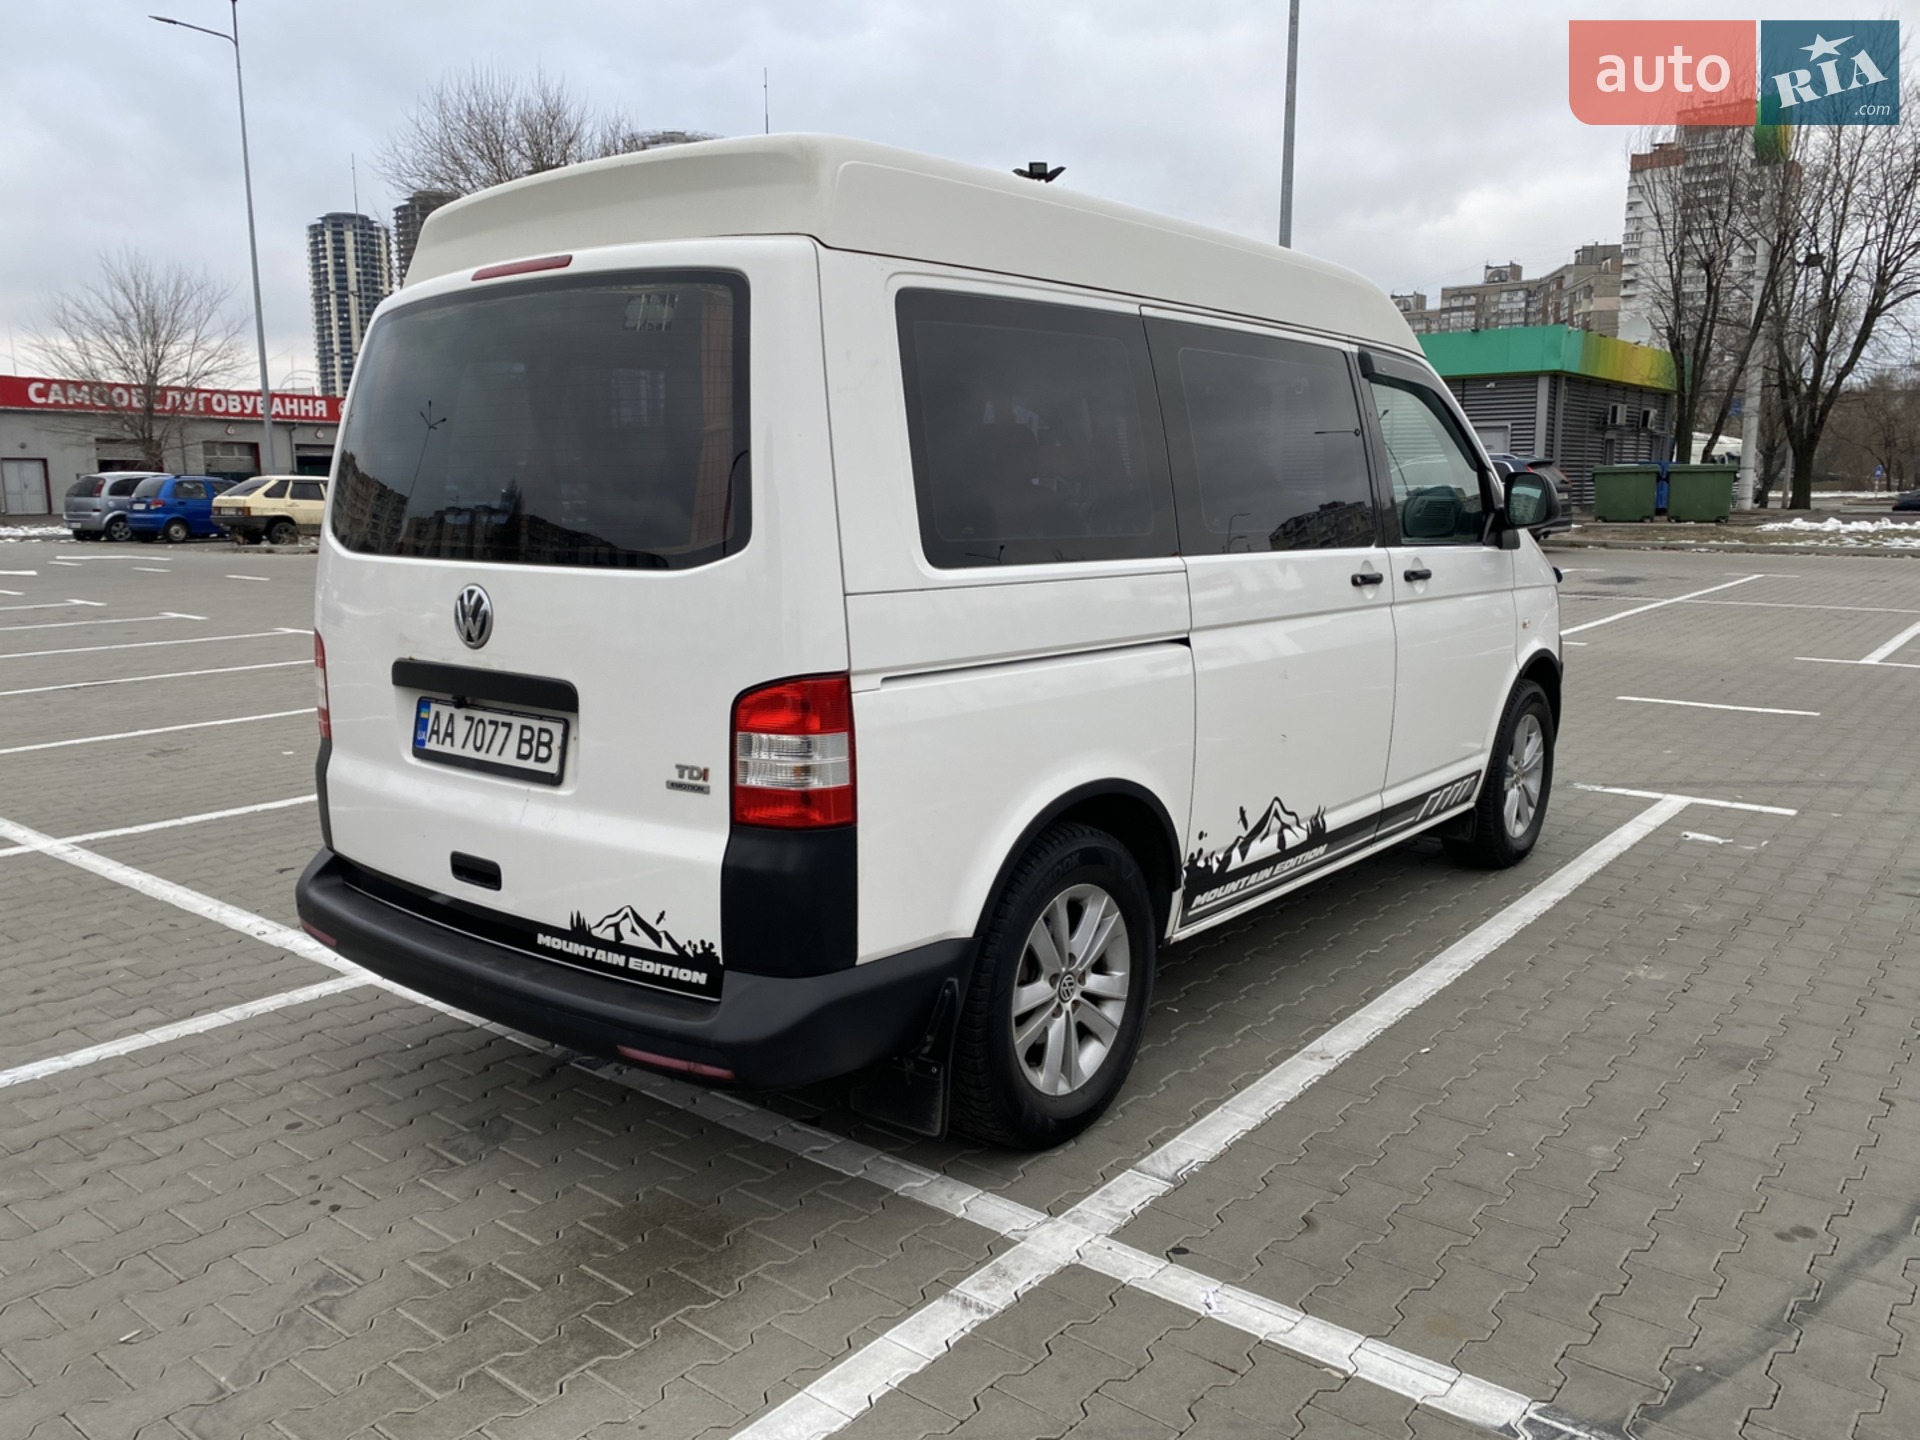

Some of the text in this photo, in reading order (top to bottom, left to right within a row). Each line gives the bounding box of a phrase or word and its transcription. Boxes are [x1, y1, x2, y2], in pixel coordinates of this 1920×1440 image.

[427, 710, 554, 764] AA 7077 BB
[675, 763, 709, 782] TDI
[1191, 843, 1328, 909] MOUNTAIN EDITION
[536, 933, 708, 985] MOUNTAIN EDITION
